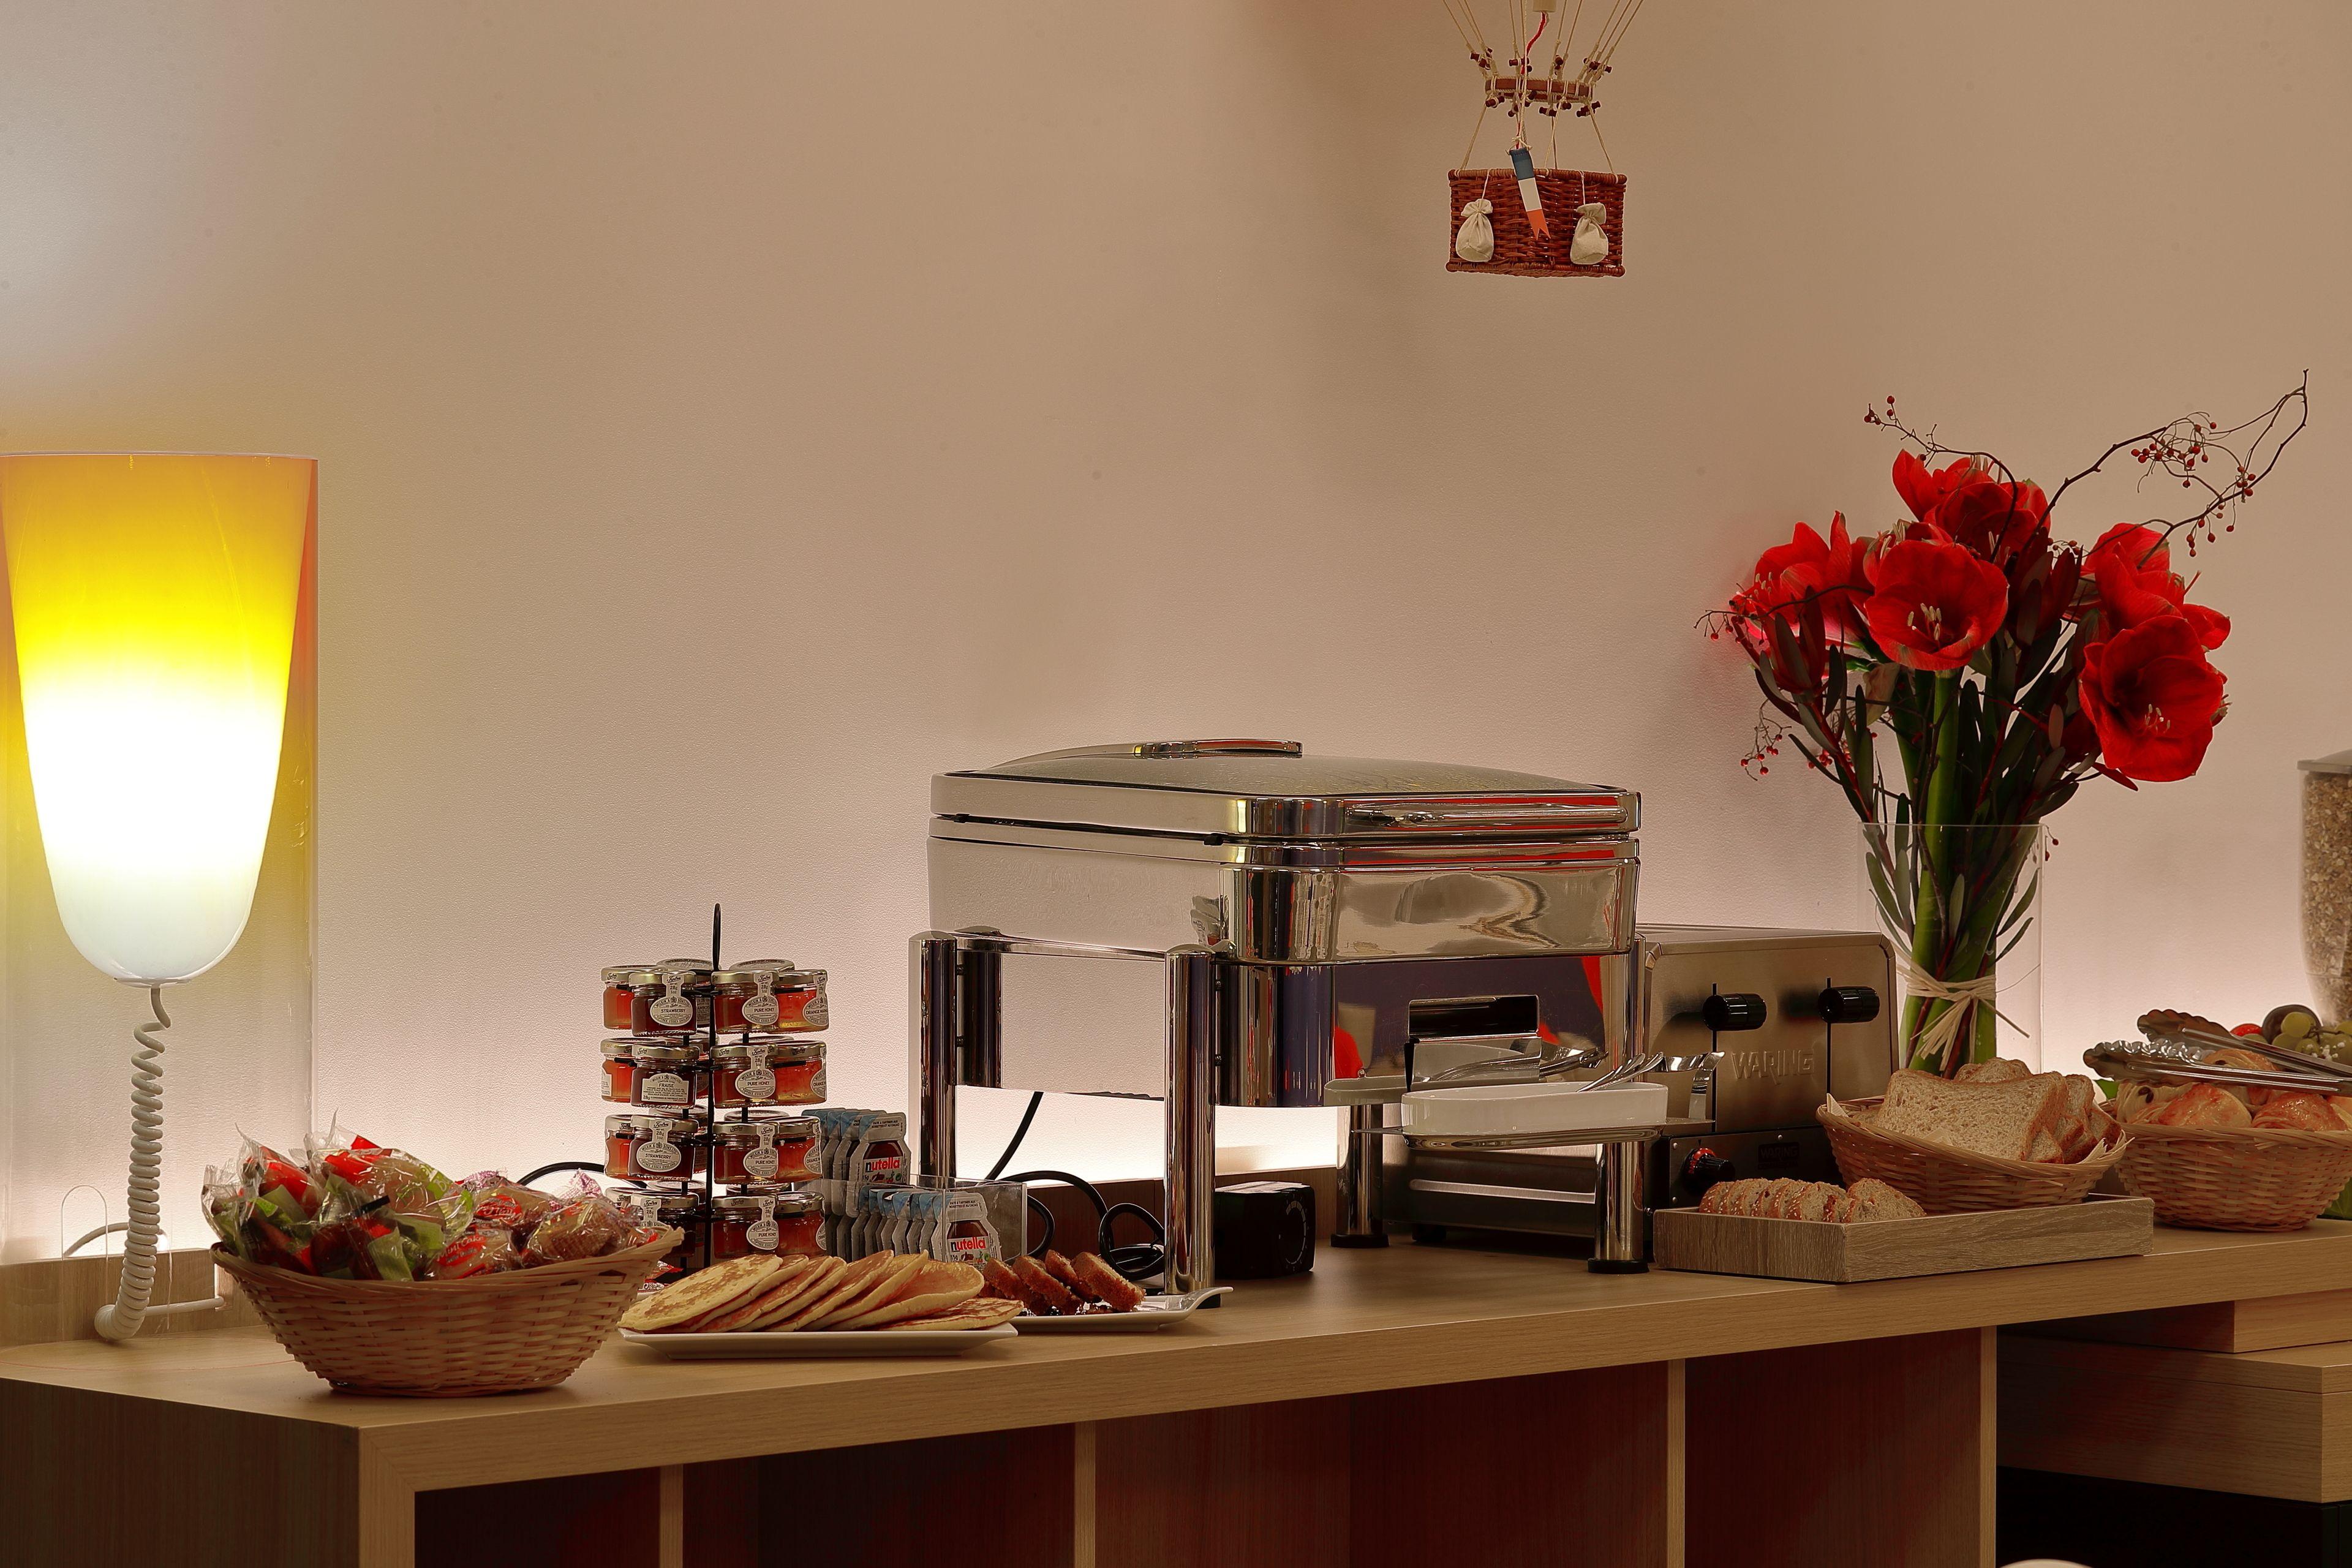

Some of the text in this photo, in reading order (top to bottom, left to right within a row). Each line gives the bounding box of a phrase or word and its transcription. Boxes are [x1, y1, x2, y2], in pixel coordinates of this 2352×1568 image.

[1731, 1049, 1815, 1085] WARING
[1760, 1146, 1798, 1162] WARING
[865, 1156, 900, 1172] nutella
[951, 1237, 986, 1251] nutella
